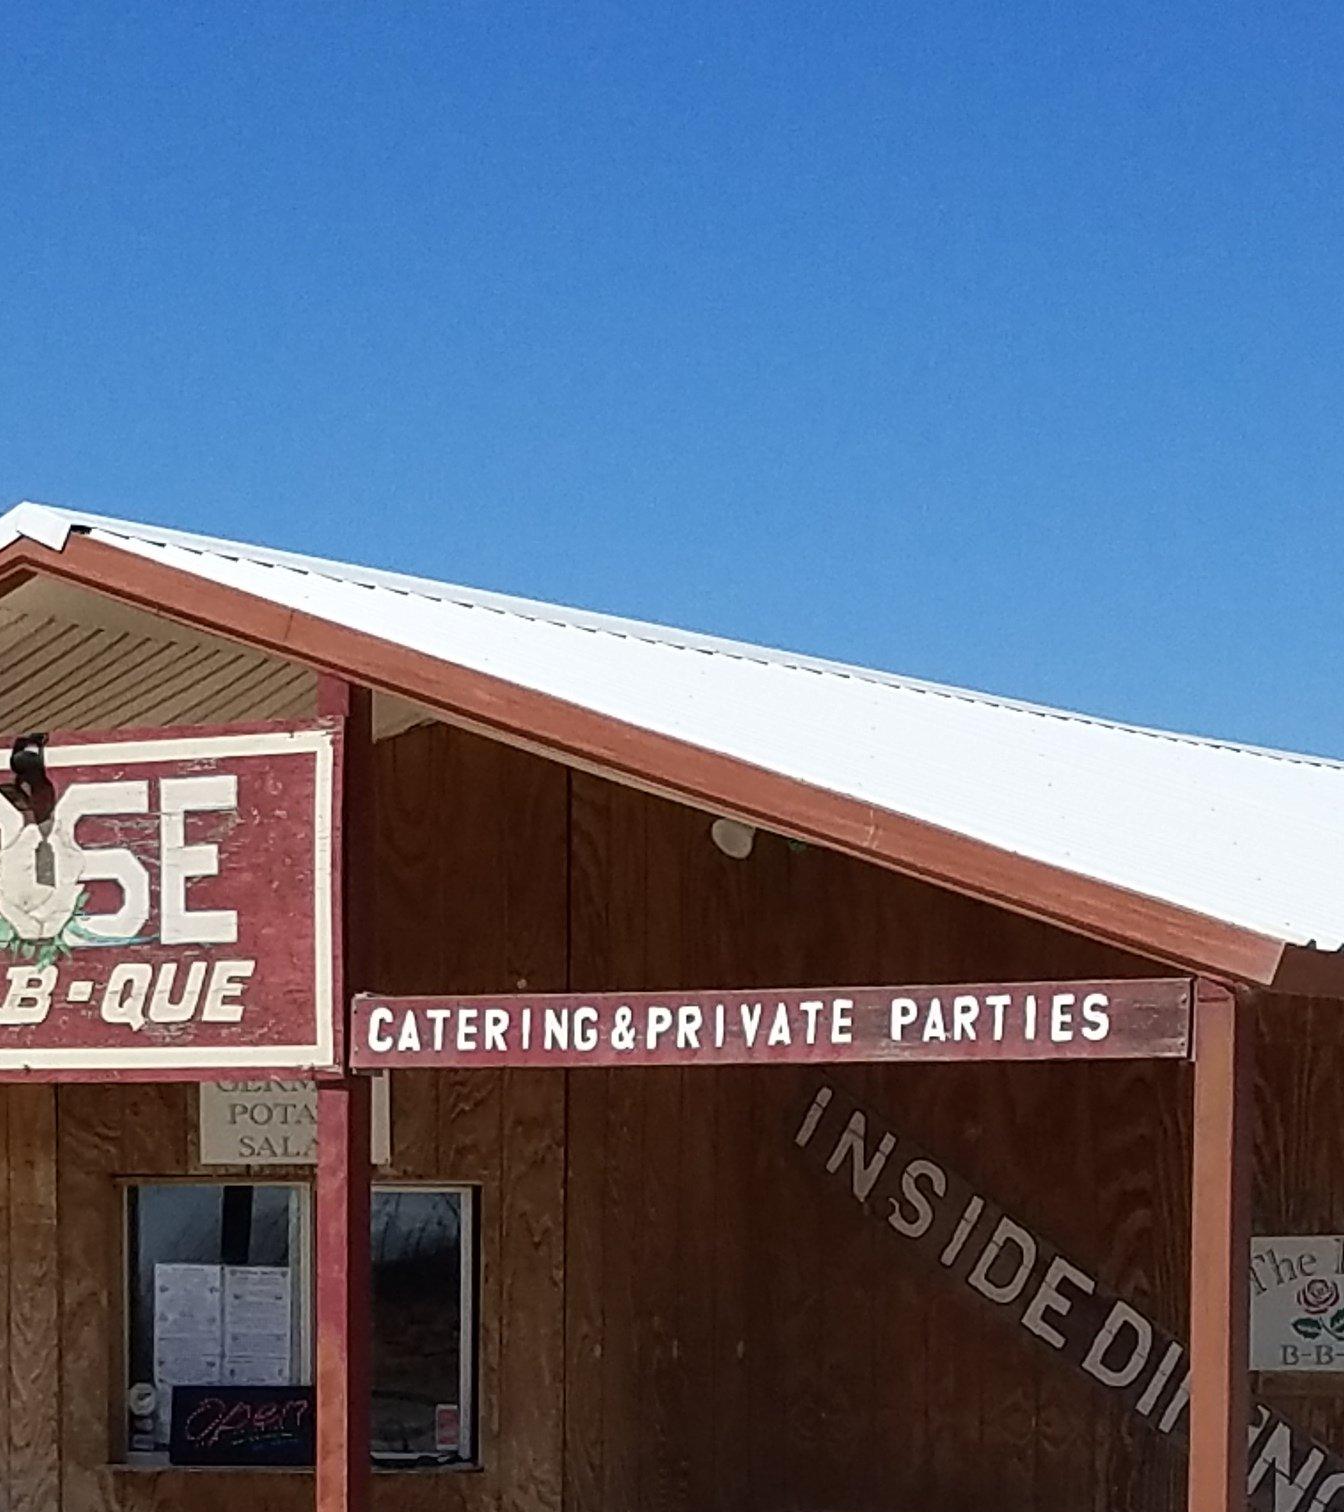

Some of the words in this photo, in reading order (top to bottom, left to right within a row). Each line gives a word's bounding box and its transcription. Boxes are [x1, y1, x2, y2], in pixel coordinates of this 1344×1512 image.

[890, 993, 1111, 1043] PARTIES
[229, 1103, 317, 1125] POTA
[795, 1086, 1095, 1348] INSIDE
[1250, 1250, 1317, 1295] The
